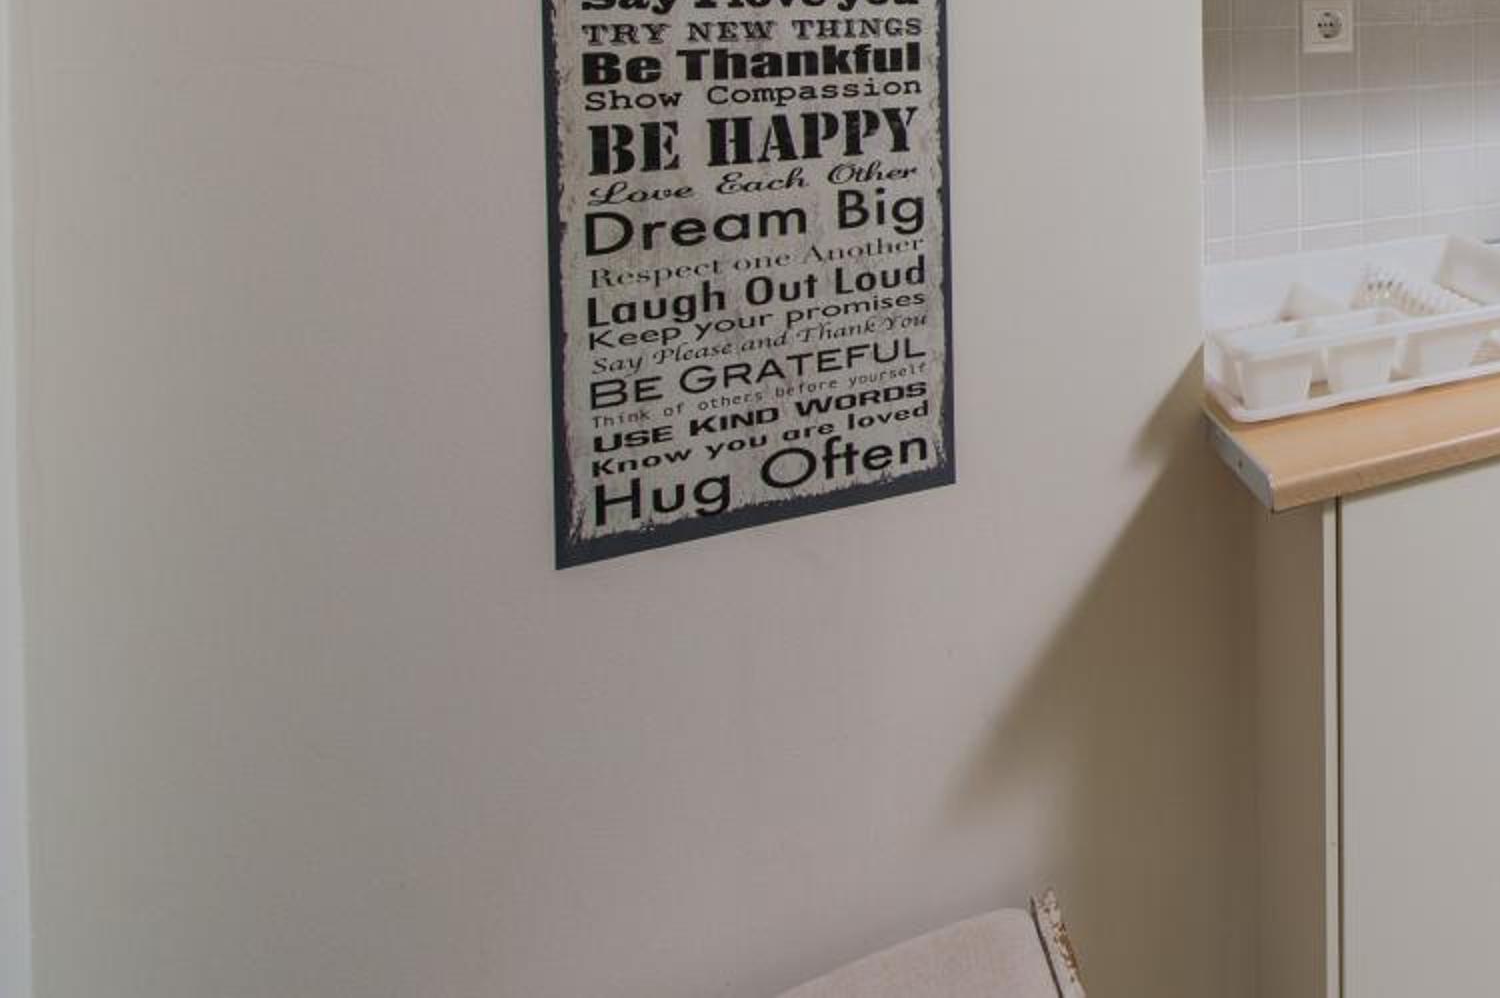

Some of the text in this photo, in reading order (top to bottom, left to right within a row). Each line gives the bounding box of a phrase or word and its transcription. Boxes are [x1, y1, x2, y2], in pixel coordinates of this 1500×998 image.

[582, 17, 922, 46] TRY NEW THINGS
[582, 42, 921, 85] Be Thankful
[585, 79, 922, 112] Show Compassion
[588, 106, 918, 176] BE HAPPY
[588, 163, 918, 206] Love Each Other
[585, 188, 924, 257] Dream Big
[588, 255, 926, 328] Laugh Out Loud
[591, 236, 924, 289] Respect one Another
[589, 294, 926, 351] Keep your promises
[592, 312, 928, 375] Say Please and Thank You
[593, 363, 928, 429] Think of others before yourself
[679, 337, 926, 394] GRATEFUL
[593, 401, 929, 478] Know you are loved
[594, 382, 927, 453] USE KIND WORDS
[596, 435, 927, 527] Hug Often
